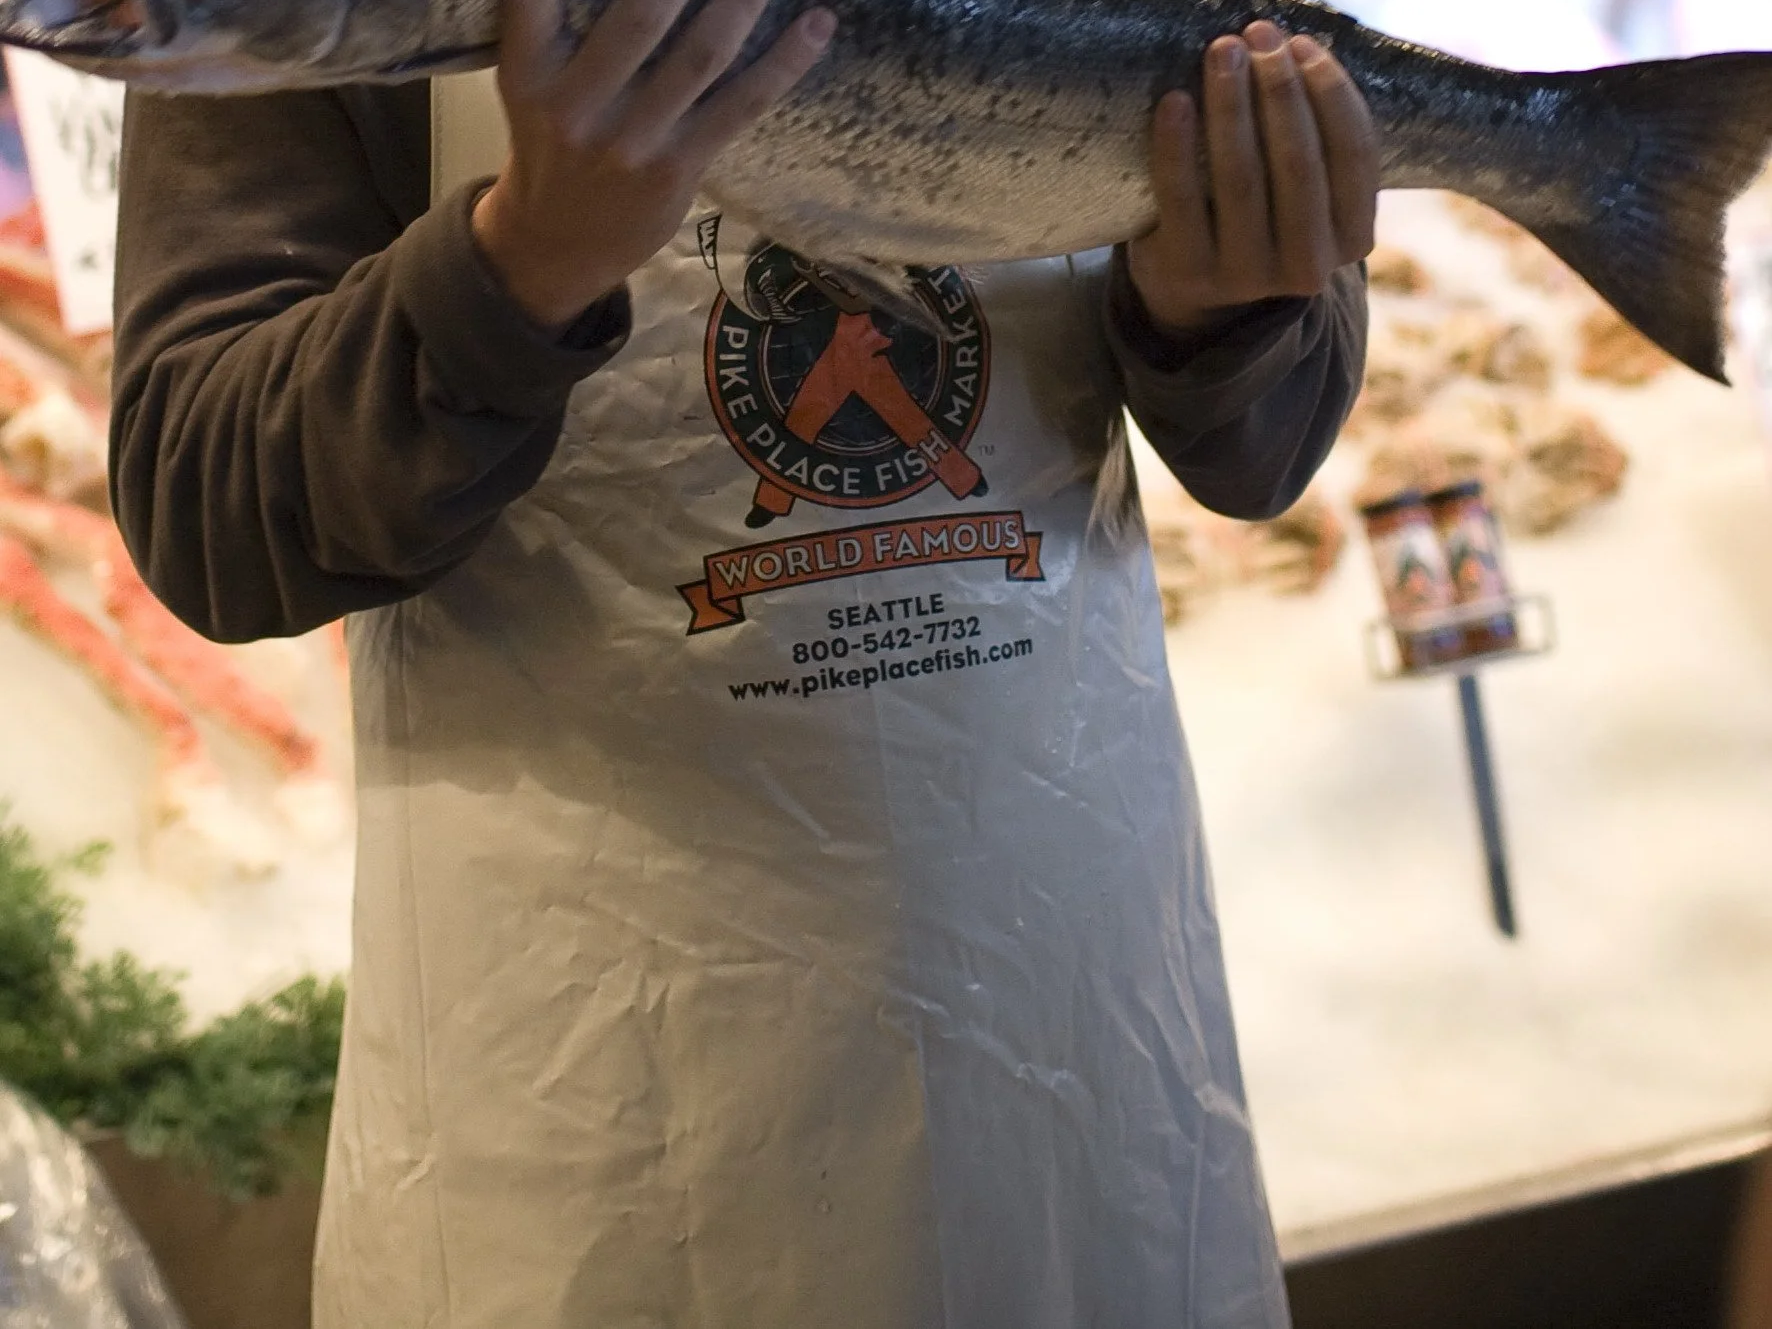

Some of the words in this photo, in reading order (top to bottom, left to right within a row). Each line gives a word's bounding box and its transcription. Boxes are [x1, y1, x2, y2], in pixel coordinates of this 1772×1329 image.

[719, 325, 758, 419] PIKE
[746, 423, 861, 495] PLACE
[874, 429, 949, 492] FISH
[927, 267, 979, 427] MARKET
[712, 537, 863, 590] WORLD
[873, 517, 1022, 562] FAMOUS
[792, 616, 982, 664] 800-542-7732
[827, 593, 945, 630] SEATTLE
[728, 636, 1034, 701] www.pikeplacefish.com
